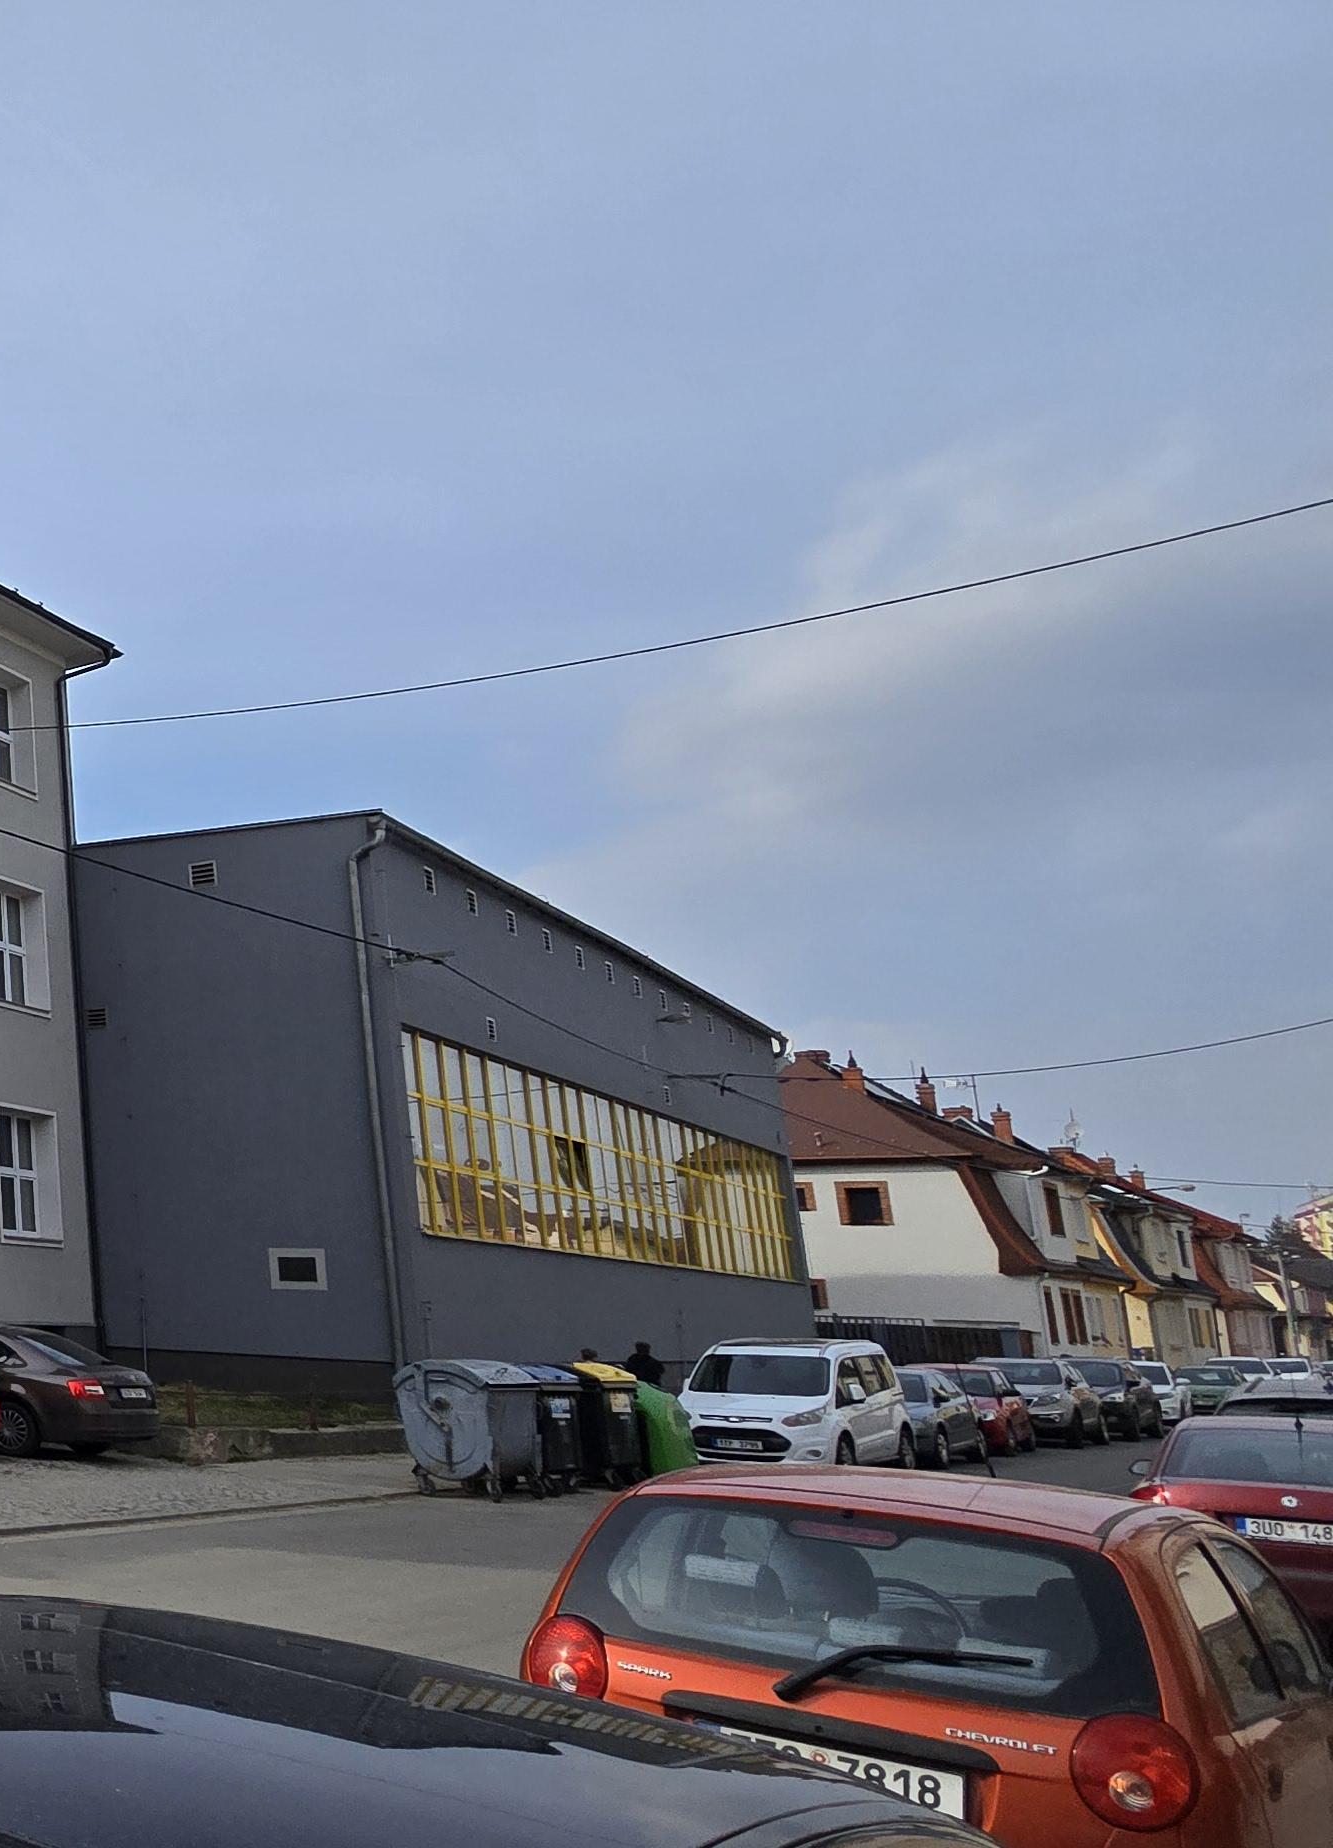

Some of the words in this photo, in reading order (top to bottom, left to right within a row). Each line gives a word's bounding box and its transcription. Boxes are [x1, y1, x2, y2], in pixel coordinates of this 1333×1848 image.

[616, 1660, 671, 1680] SPARK
[944, 1726, 1058, 1756] CHEVROLET
[836, 1755, 942, 1809] 7818
